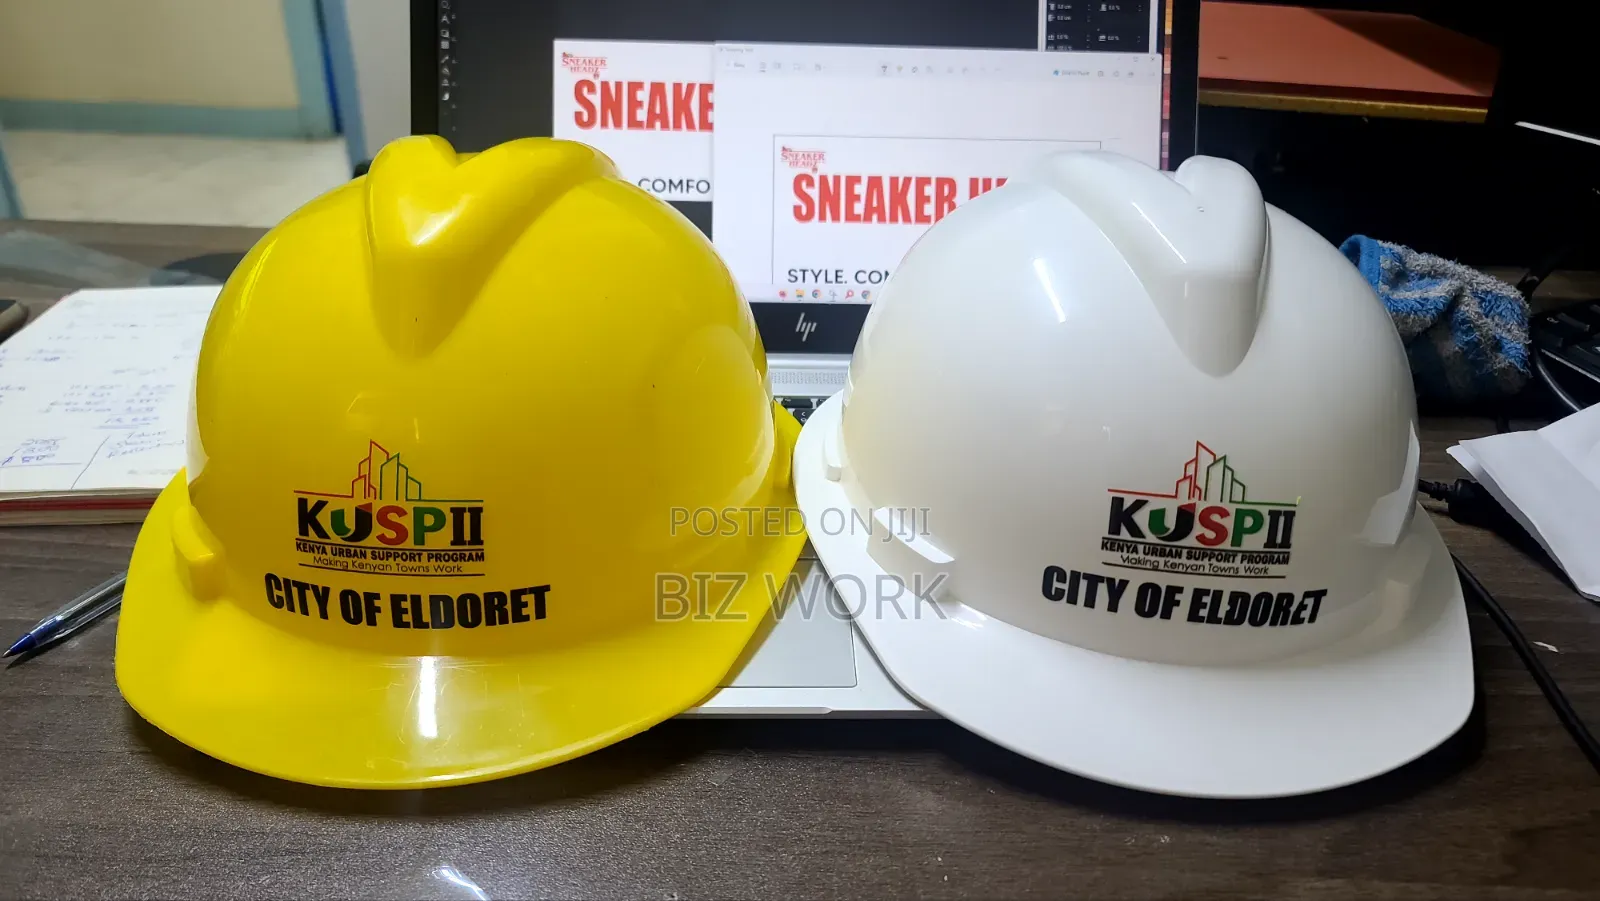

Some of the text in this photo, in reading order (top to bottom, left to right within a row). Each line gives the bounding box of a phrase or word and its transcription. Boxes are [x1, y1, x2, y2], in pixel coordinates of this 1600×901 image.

[562, 58, 607, 66] SNEAKER
[574, 79, 713, 132] SNEAKE
[781, 151, 825, 160] SNEAKER
[638, 178, 711, 194] COMFO
[792, 173, 957, 225] SNEAKER
[787, 268, 848, 284] STYLE.
[795, 312, 817, 342] hp
[296, 541, 485, 563] KENYA URBAN SUPPORT PROGRAM
[1101, 540, 1290, 565] KENYA URBAN SUPPORT PROGRAM
[313, 555, 463, 573] Making Kenyan Towns Work
[1120, 554, 1270, 575] Making Kenyan Towns Work
[264, 572, 551, 630] CITY OF ELDORET
[1041, 565, 1328, 628] CITY OF ELDORET
